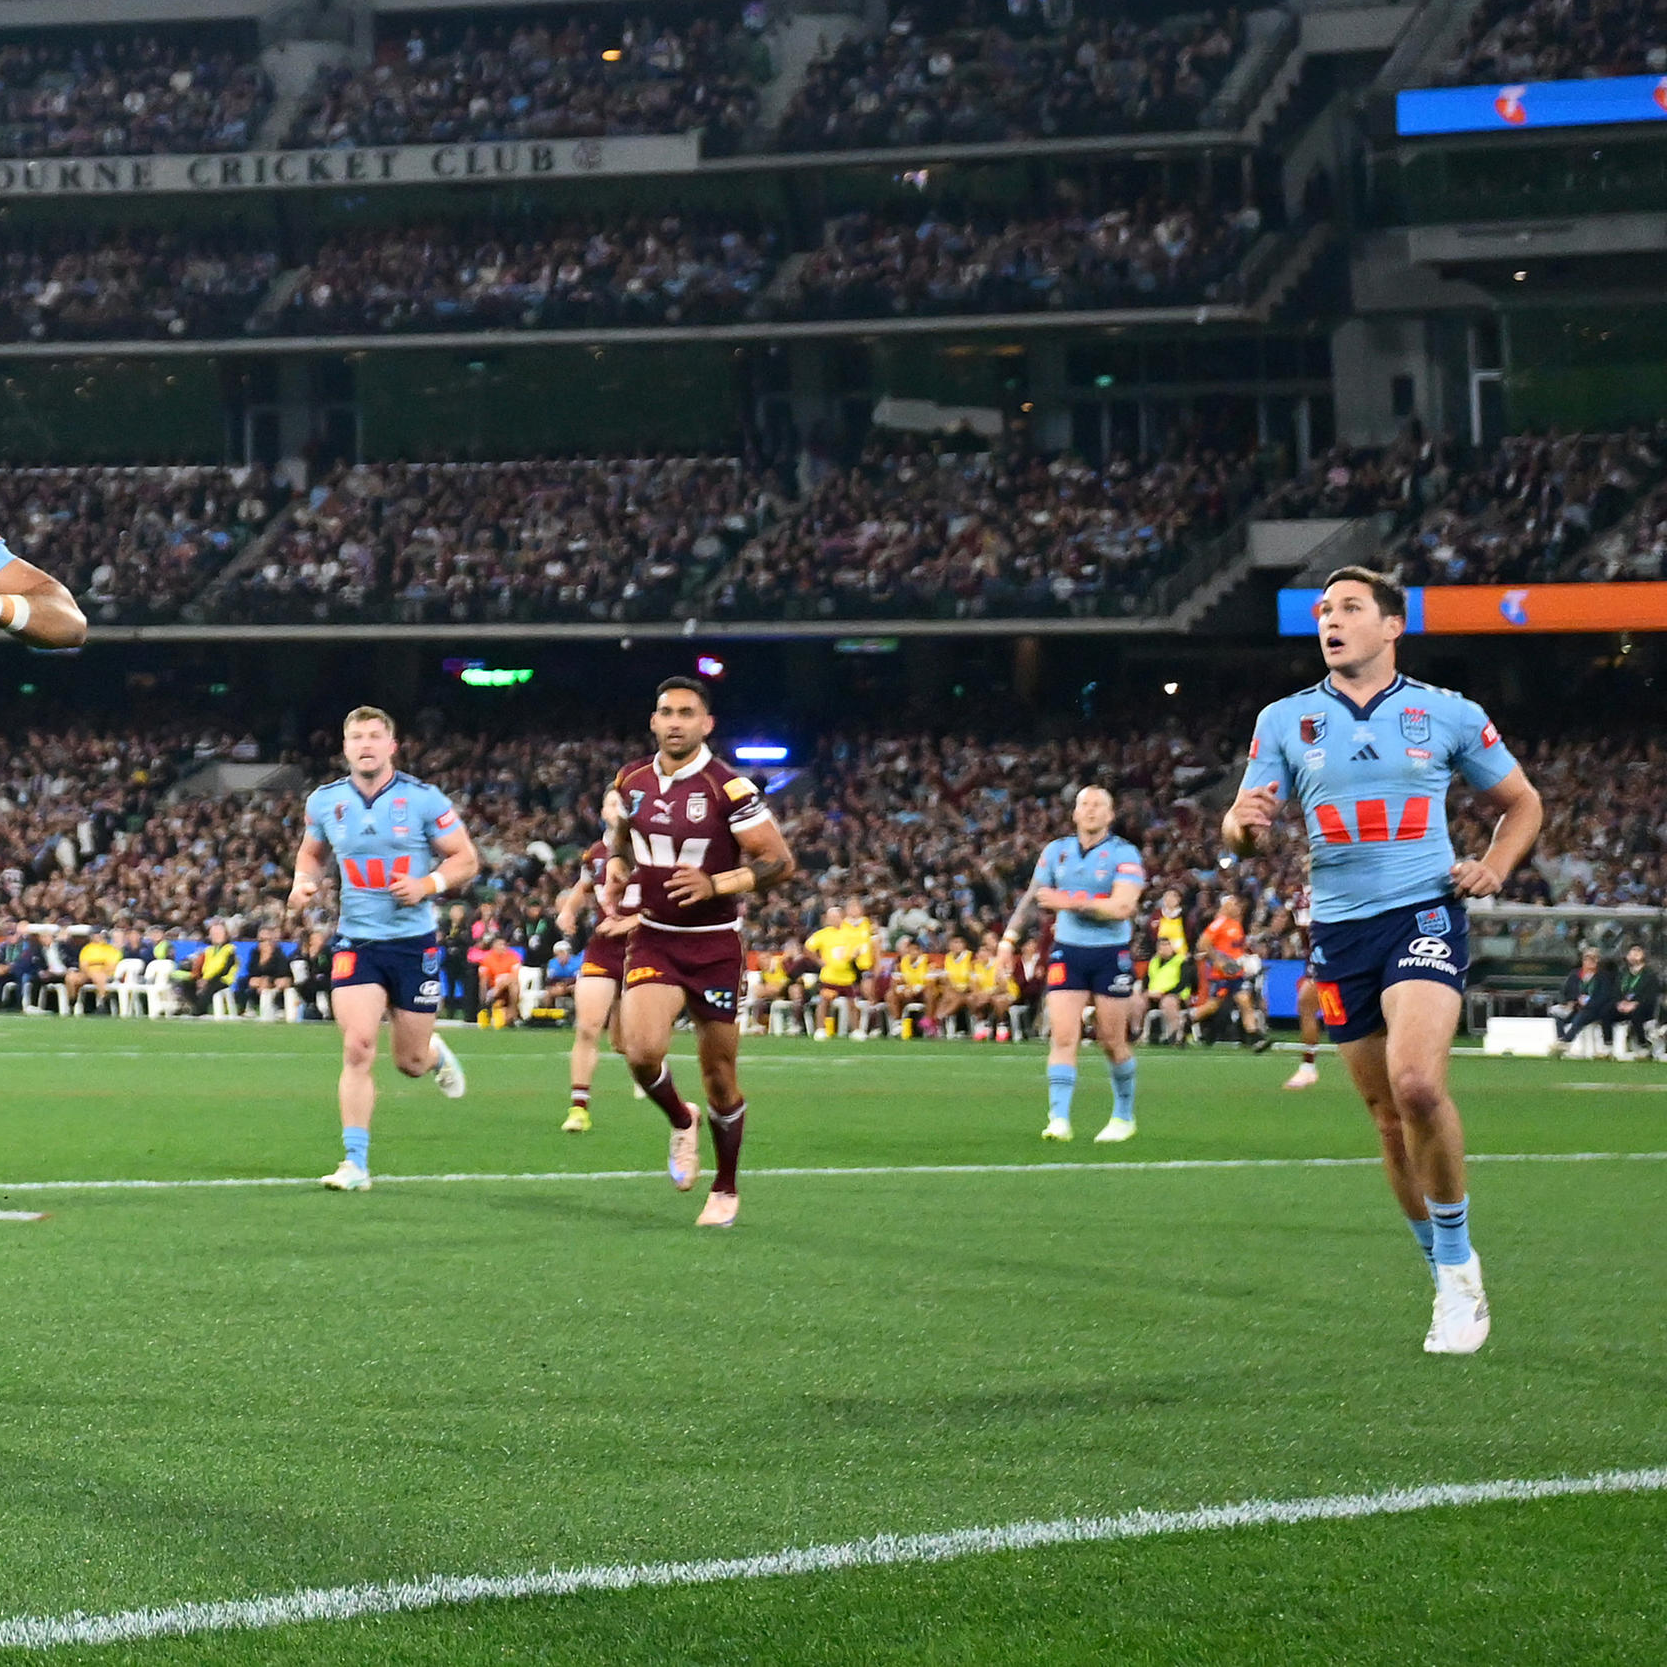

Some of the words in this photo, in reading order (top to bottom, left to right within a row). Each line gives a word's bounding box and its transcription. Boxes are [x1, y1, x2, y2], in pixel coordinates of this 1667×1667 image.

[187, 151, 400, 188] CRICKET
[431, 144, 555, 177] CLUB
[1397, 956, 1458, 977] HYUNDAI
